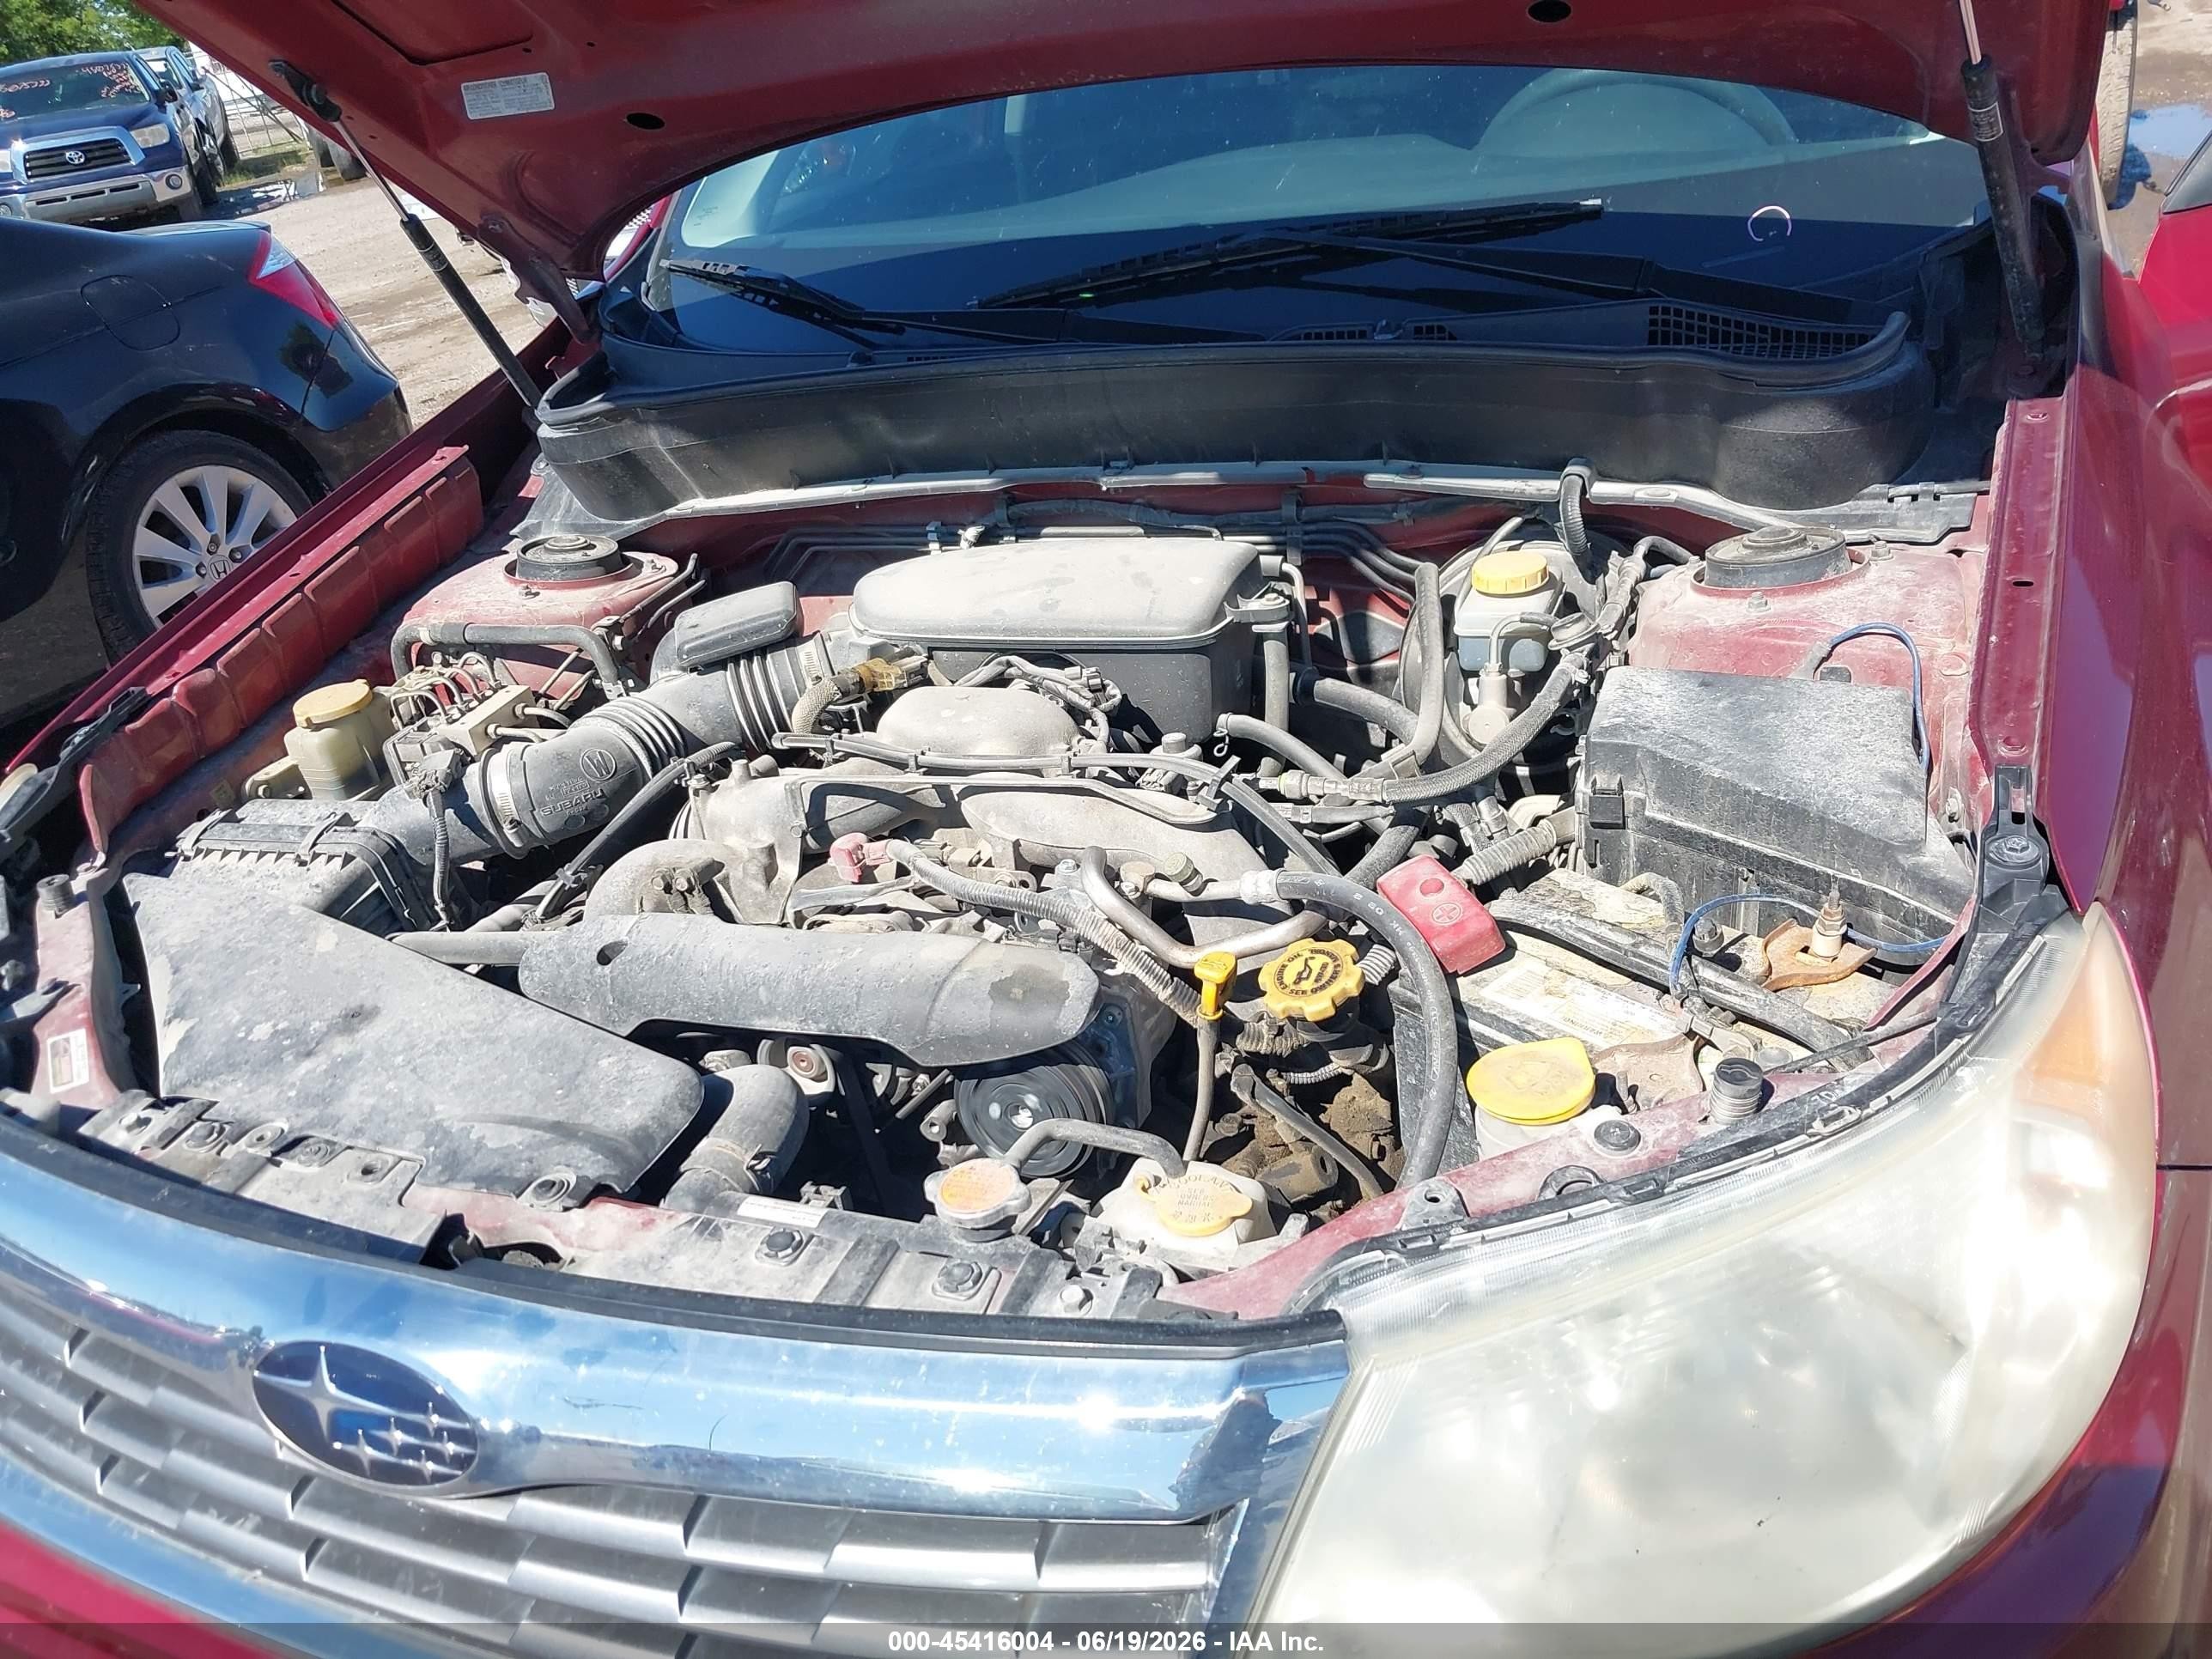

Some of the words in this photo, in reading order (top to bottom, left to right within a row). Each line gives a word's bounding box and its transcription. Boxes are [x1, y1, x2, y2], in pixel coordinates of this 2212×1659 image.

[540, 788, 605, 816] SUBARU
[1310, 948, 1340, 963] MANUAL
[1276, 963, 1288, 991] ENGINE
[1287, 953, 1304, 963] OIL
